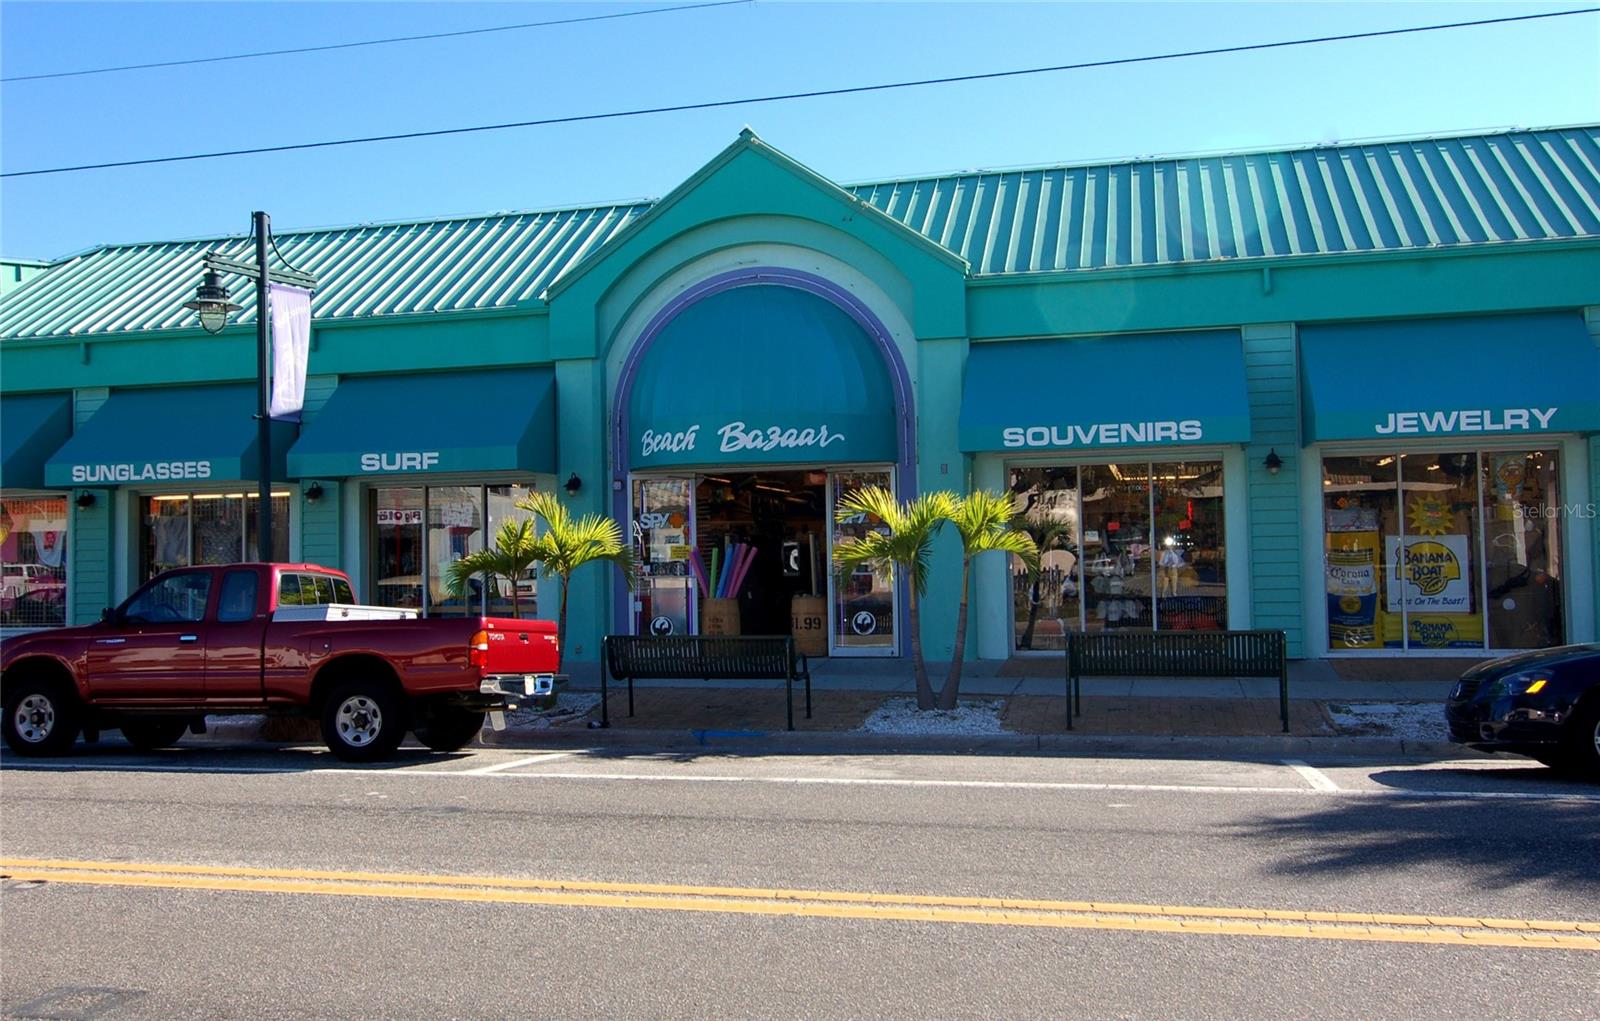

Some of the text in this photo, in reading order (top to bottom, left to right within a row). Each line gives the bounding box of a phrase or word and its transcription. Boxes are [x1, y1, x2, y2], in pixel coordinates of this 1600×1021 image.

[1375, 408, 1558, 434] JEWELRY
[641, 421, 845, 456] Beach Bazaar
[1003, 420, 1203, 447] SOUVENIRS
[72, 461, 211, 482] SUNGLASSES
[361, 452, 440, 471] SURF
[640, 512, 670, 529] SPY
[1330, 567, 1370, 579] Corona
[1409, 565, 1444, 581] BOAT
